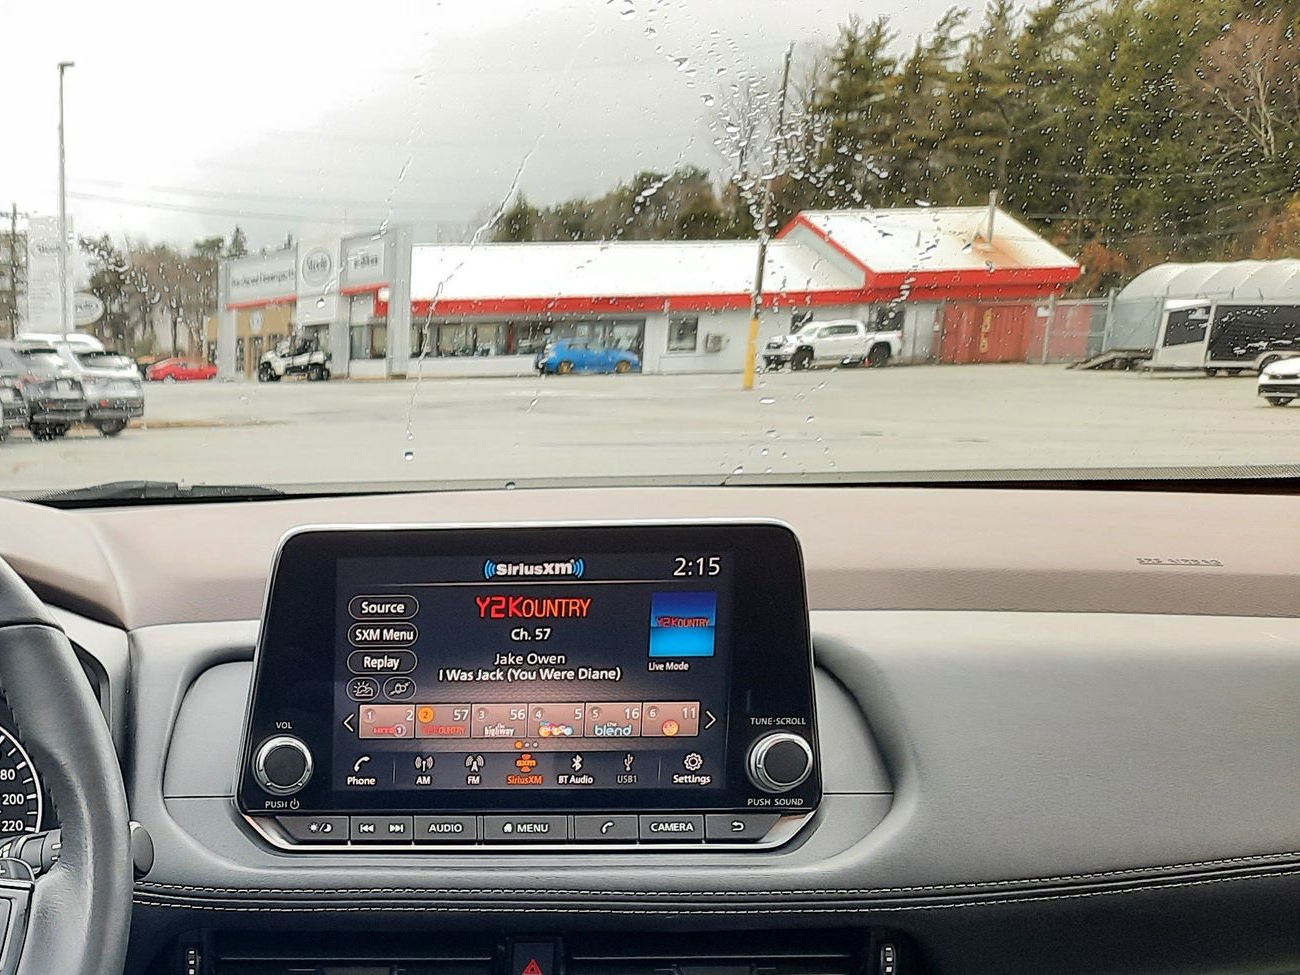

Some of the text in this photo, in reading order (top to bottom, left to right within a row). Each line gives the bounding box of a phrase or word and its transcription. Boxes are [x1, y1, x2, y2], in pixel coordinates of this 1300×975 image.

[673, 557, 721, 576] 2:15
[361, 602, 405, 614] Source
[476, 596, 592, 618] Y2KOUNTRY
[355, 629, 414, 641] SXM Menu
[511, 628, 551, 641] Ch. 57
[364, 657, 400, 670] Replay
[494, 653, 566, 666] Jake Owen
[649, 661, 689, 671] Live Mode
[439, 667, 621, 682] I Was Jack (You Were Diane)
[406, 709, 413, 721] 2
[453, 709, 469, 720] 57
[479, 711, 485, 719] 3
[510, 709, 526, 720] 56
[535, 711, 542, 719] 4
[575, 708, 582, 720] 5
[625, 708, 639, 719] 16
[649, 709, 656, 718] 6
[682, 707, 696, 718] 11
[275, 721, 292, 730] VOL
[594, 725, 631, 736] blend
[347, 776, 376, 785] Phone
[416, 776, 431, 785] AM
[467, 776, 480, 784] FM
[507, 775, 543, 784] SiriusXM
[558, 775, 593, 784] BT Audio
[617, 775, 637, 784] USB1
[673, 774, 711, 785] Settings
[2, 794, 24, 806] 200
[265, 801, 288, 809] PUSH
[747, 798, 803, 806] PUSH SOUND
[1, 820, 23, 832] 220
[428, 823, 463, 833] AUDIO
[517, 823, 549, 833] MENU
[650, 822, 694, 832] CAMERA
